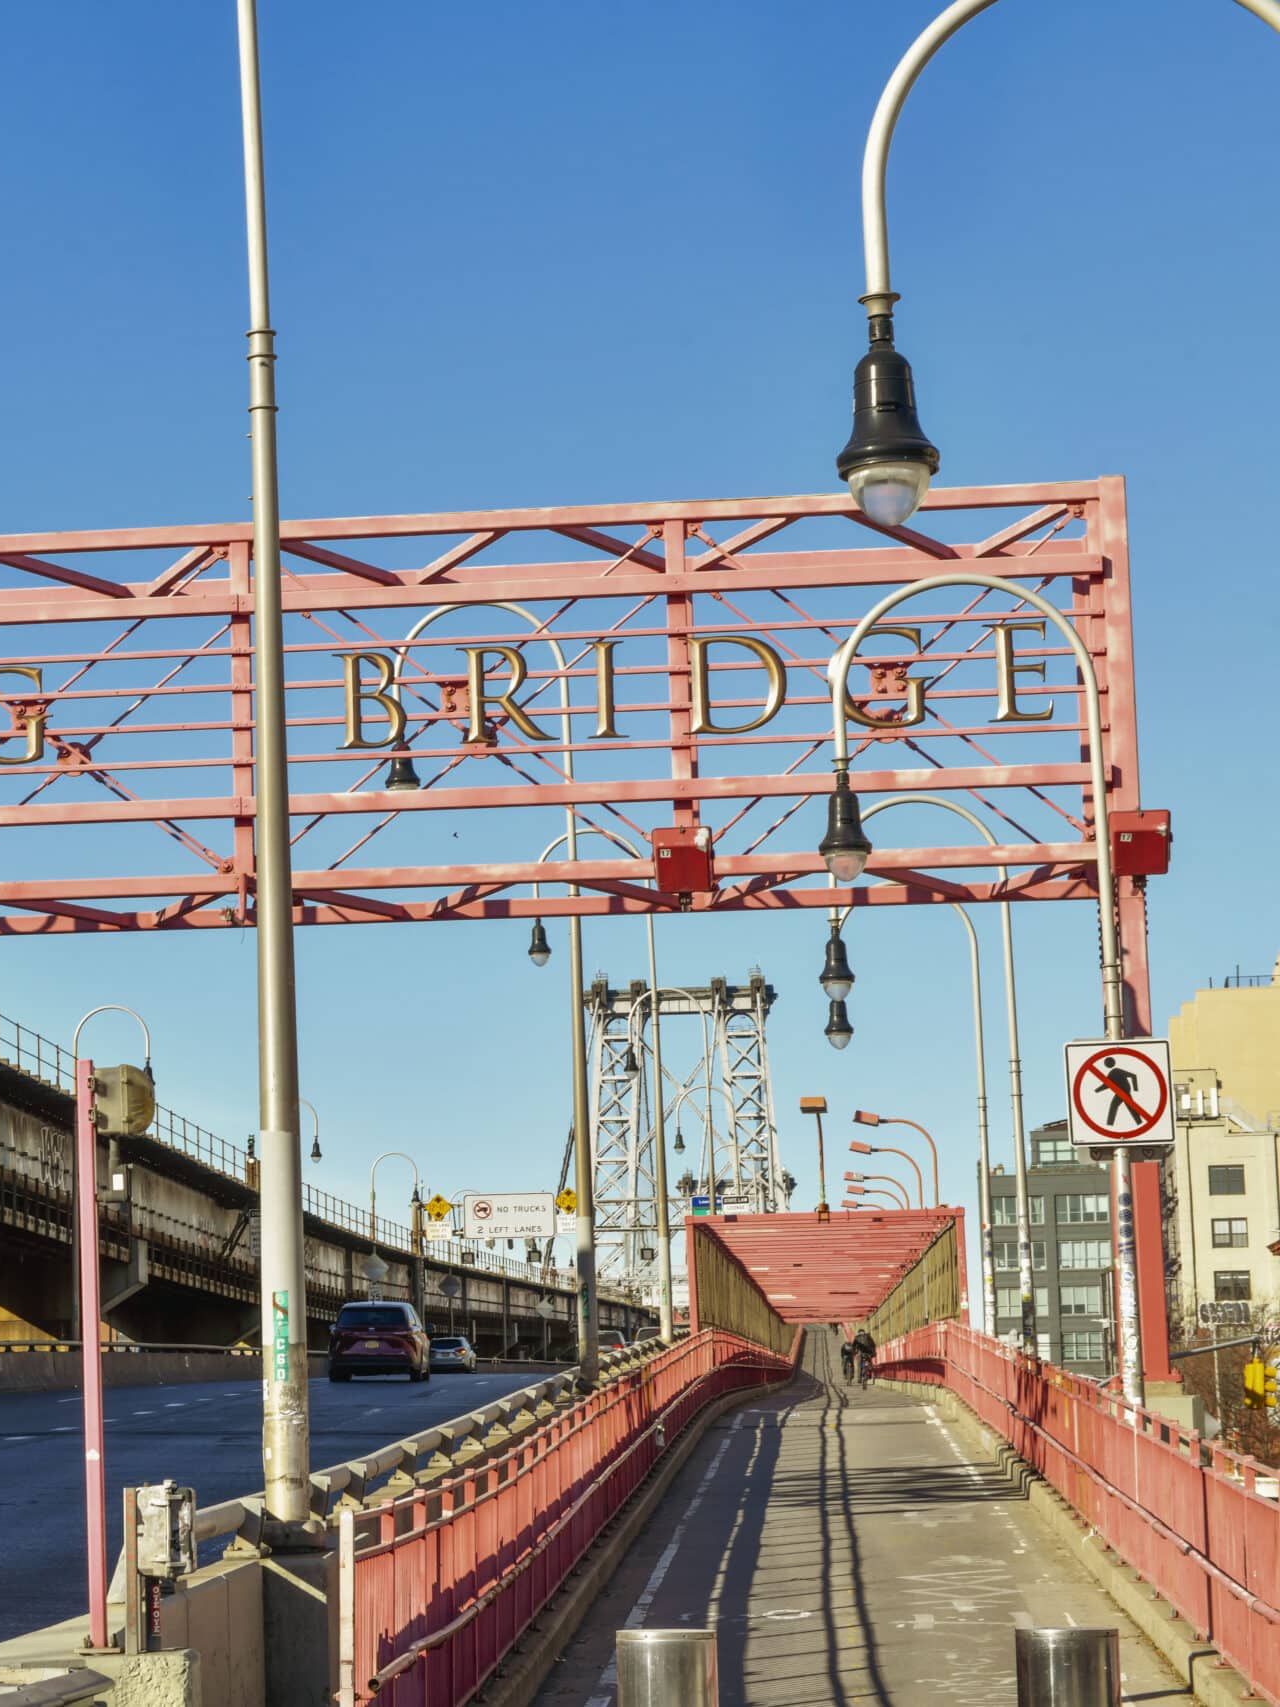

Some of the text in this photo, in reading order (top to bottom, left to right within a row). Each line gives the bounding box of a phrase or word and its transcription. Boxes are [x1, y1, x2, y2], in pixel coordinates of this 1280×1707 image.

[333, 620, 1055, 749] BRIDGE
[513, 1205, 547, 1213] TRUCKS
[477, 1226, 484, 1234] 2
